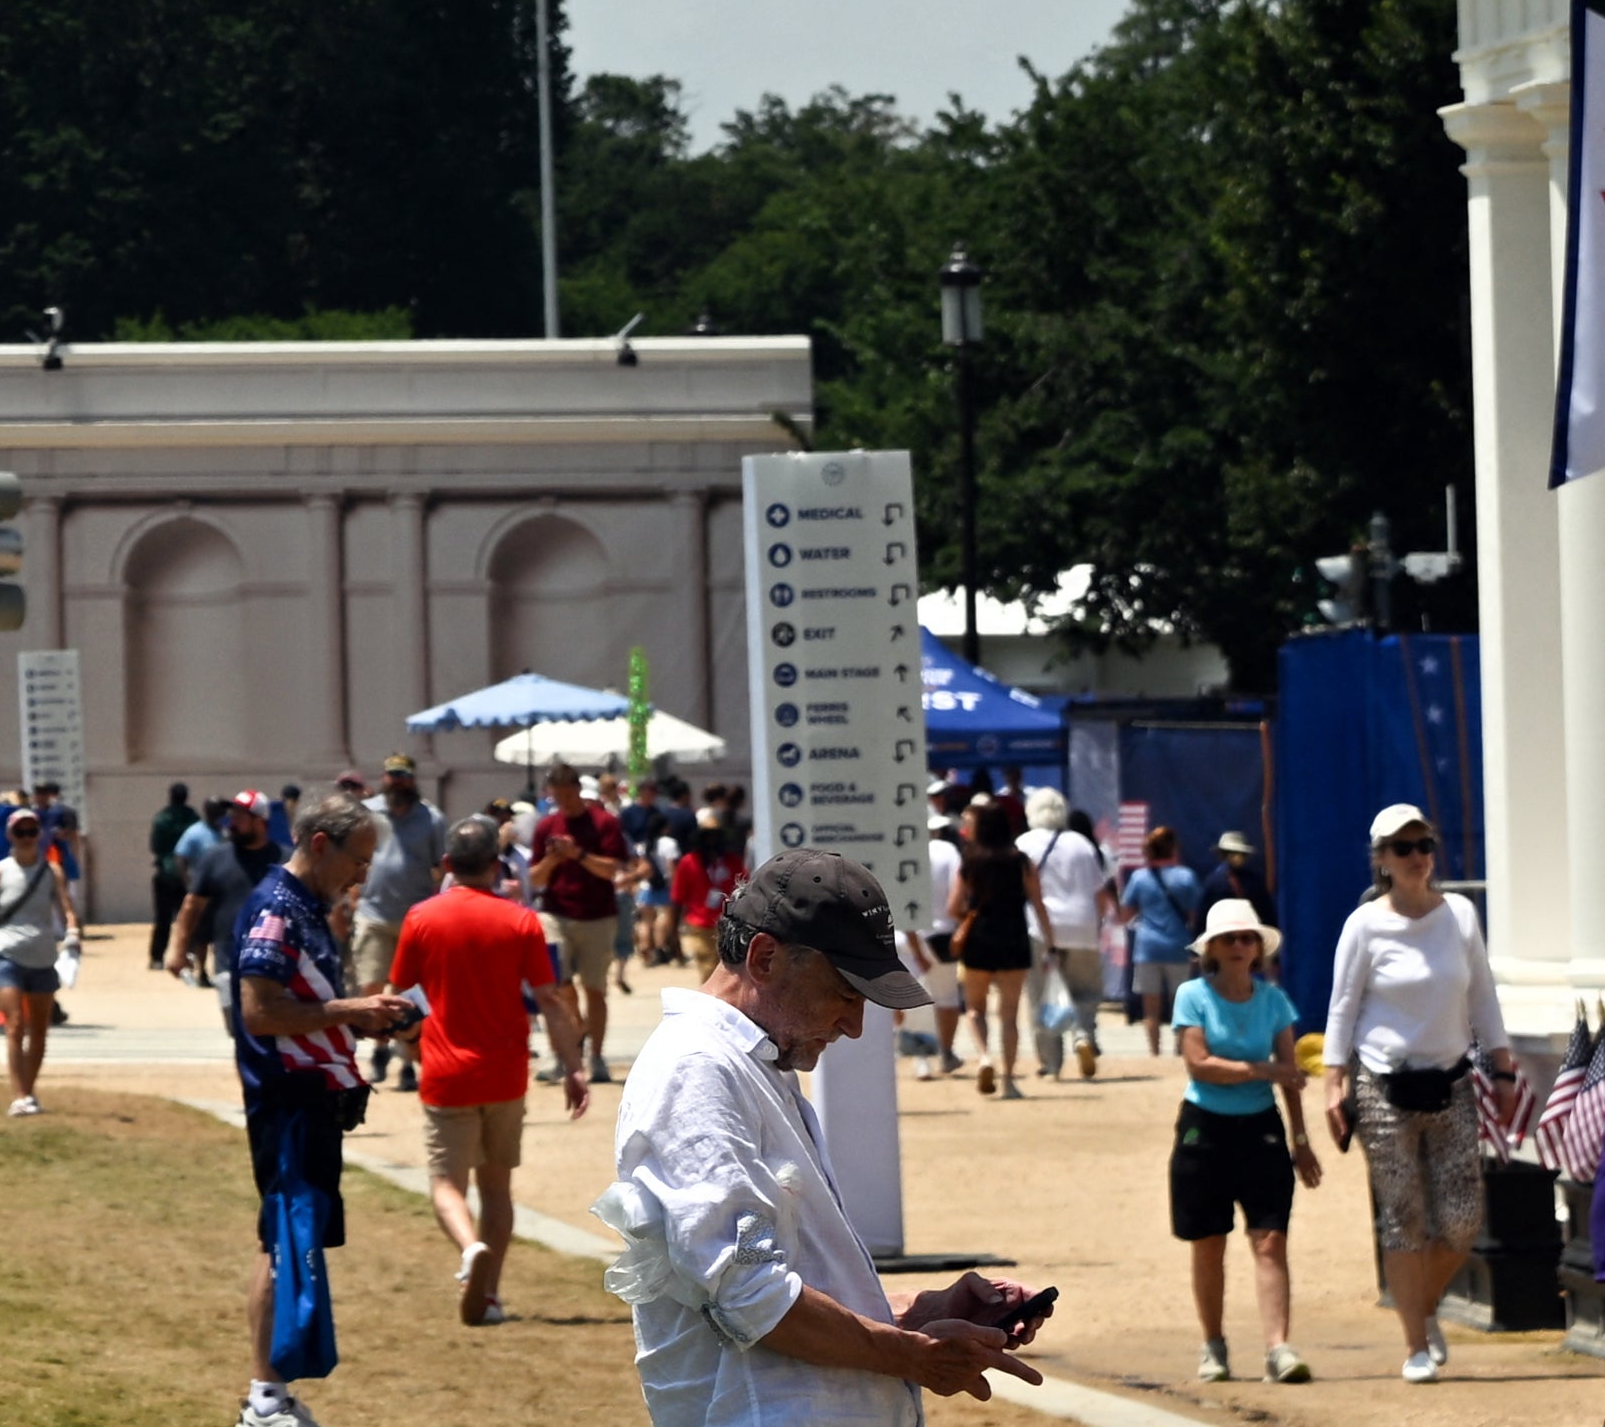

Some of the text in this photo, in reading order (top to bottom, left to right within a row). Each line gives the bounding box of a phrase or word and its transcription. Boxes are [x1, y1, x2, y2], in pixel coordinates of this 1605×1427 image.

[796, 506, 864, 521] MEDICAL
[799, 547, 851, 561] WATER
[800, 587, 877, 599] RESTROOMS
[803, 626, 836, 641] EXIT
[804, 666, 881, 680] MAIN STAGE
[806, 702, 849, 713] FERRIS
[807, 715, 850, 725] WHEEL
[809, 747, 861, 761] ARENA
[810, 782, 845, 793] FOOD
[811, 794, 875, 806] BEVERAGE
